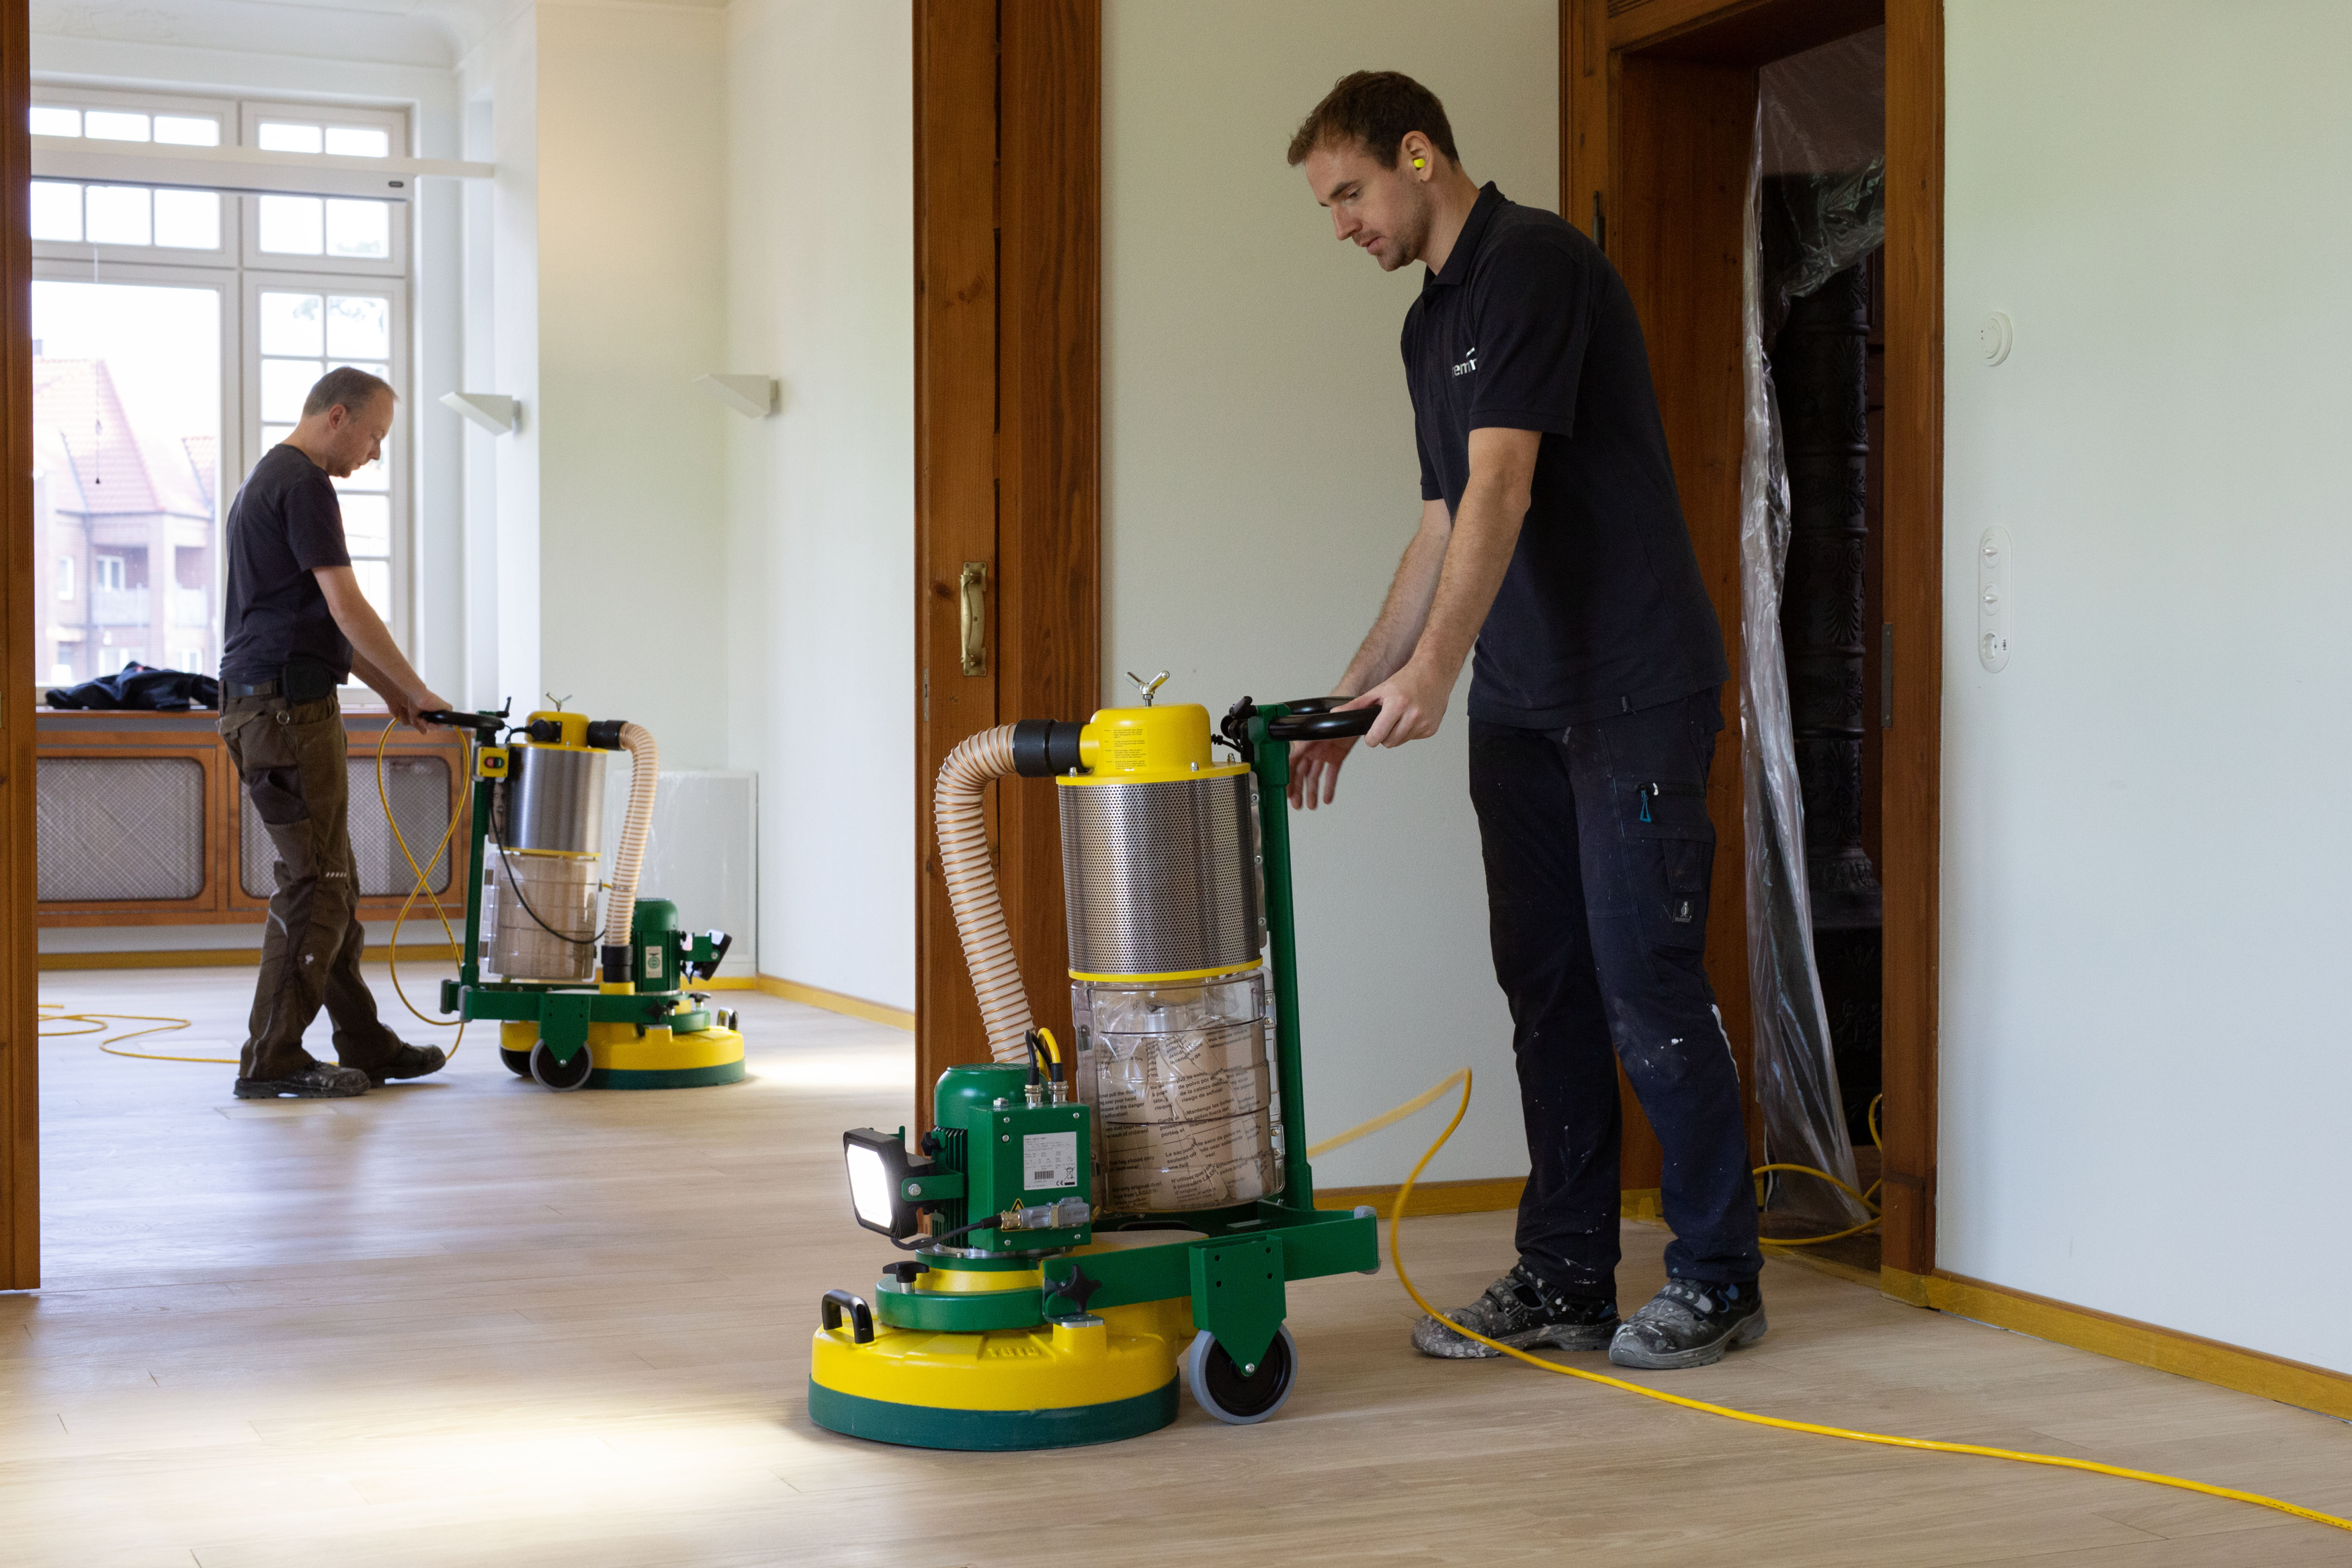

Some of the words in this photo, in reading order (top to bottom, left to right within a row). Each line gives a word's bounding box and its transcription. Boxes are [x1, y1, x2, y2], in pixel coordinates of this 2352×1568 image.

[1185, 1080, 1200, 1088] polvo
[1193, 1084, 1211, 1092] cabeza
[1206, 1087, 1223, 1096] asfixia!
[1220, 1098, 1234, 1106] bolsas
[1194, 1113, 1208, 1121] polvo
[1175, 1186, 1198, 1194] d'origine
